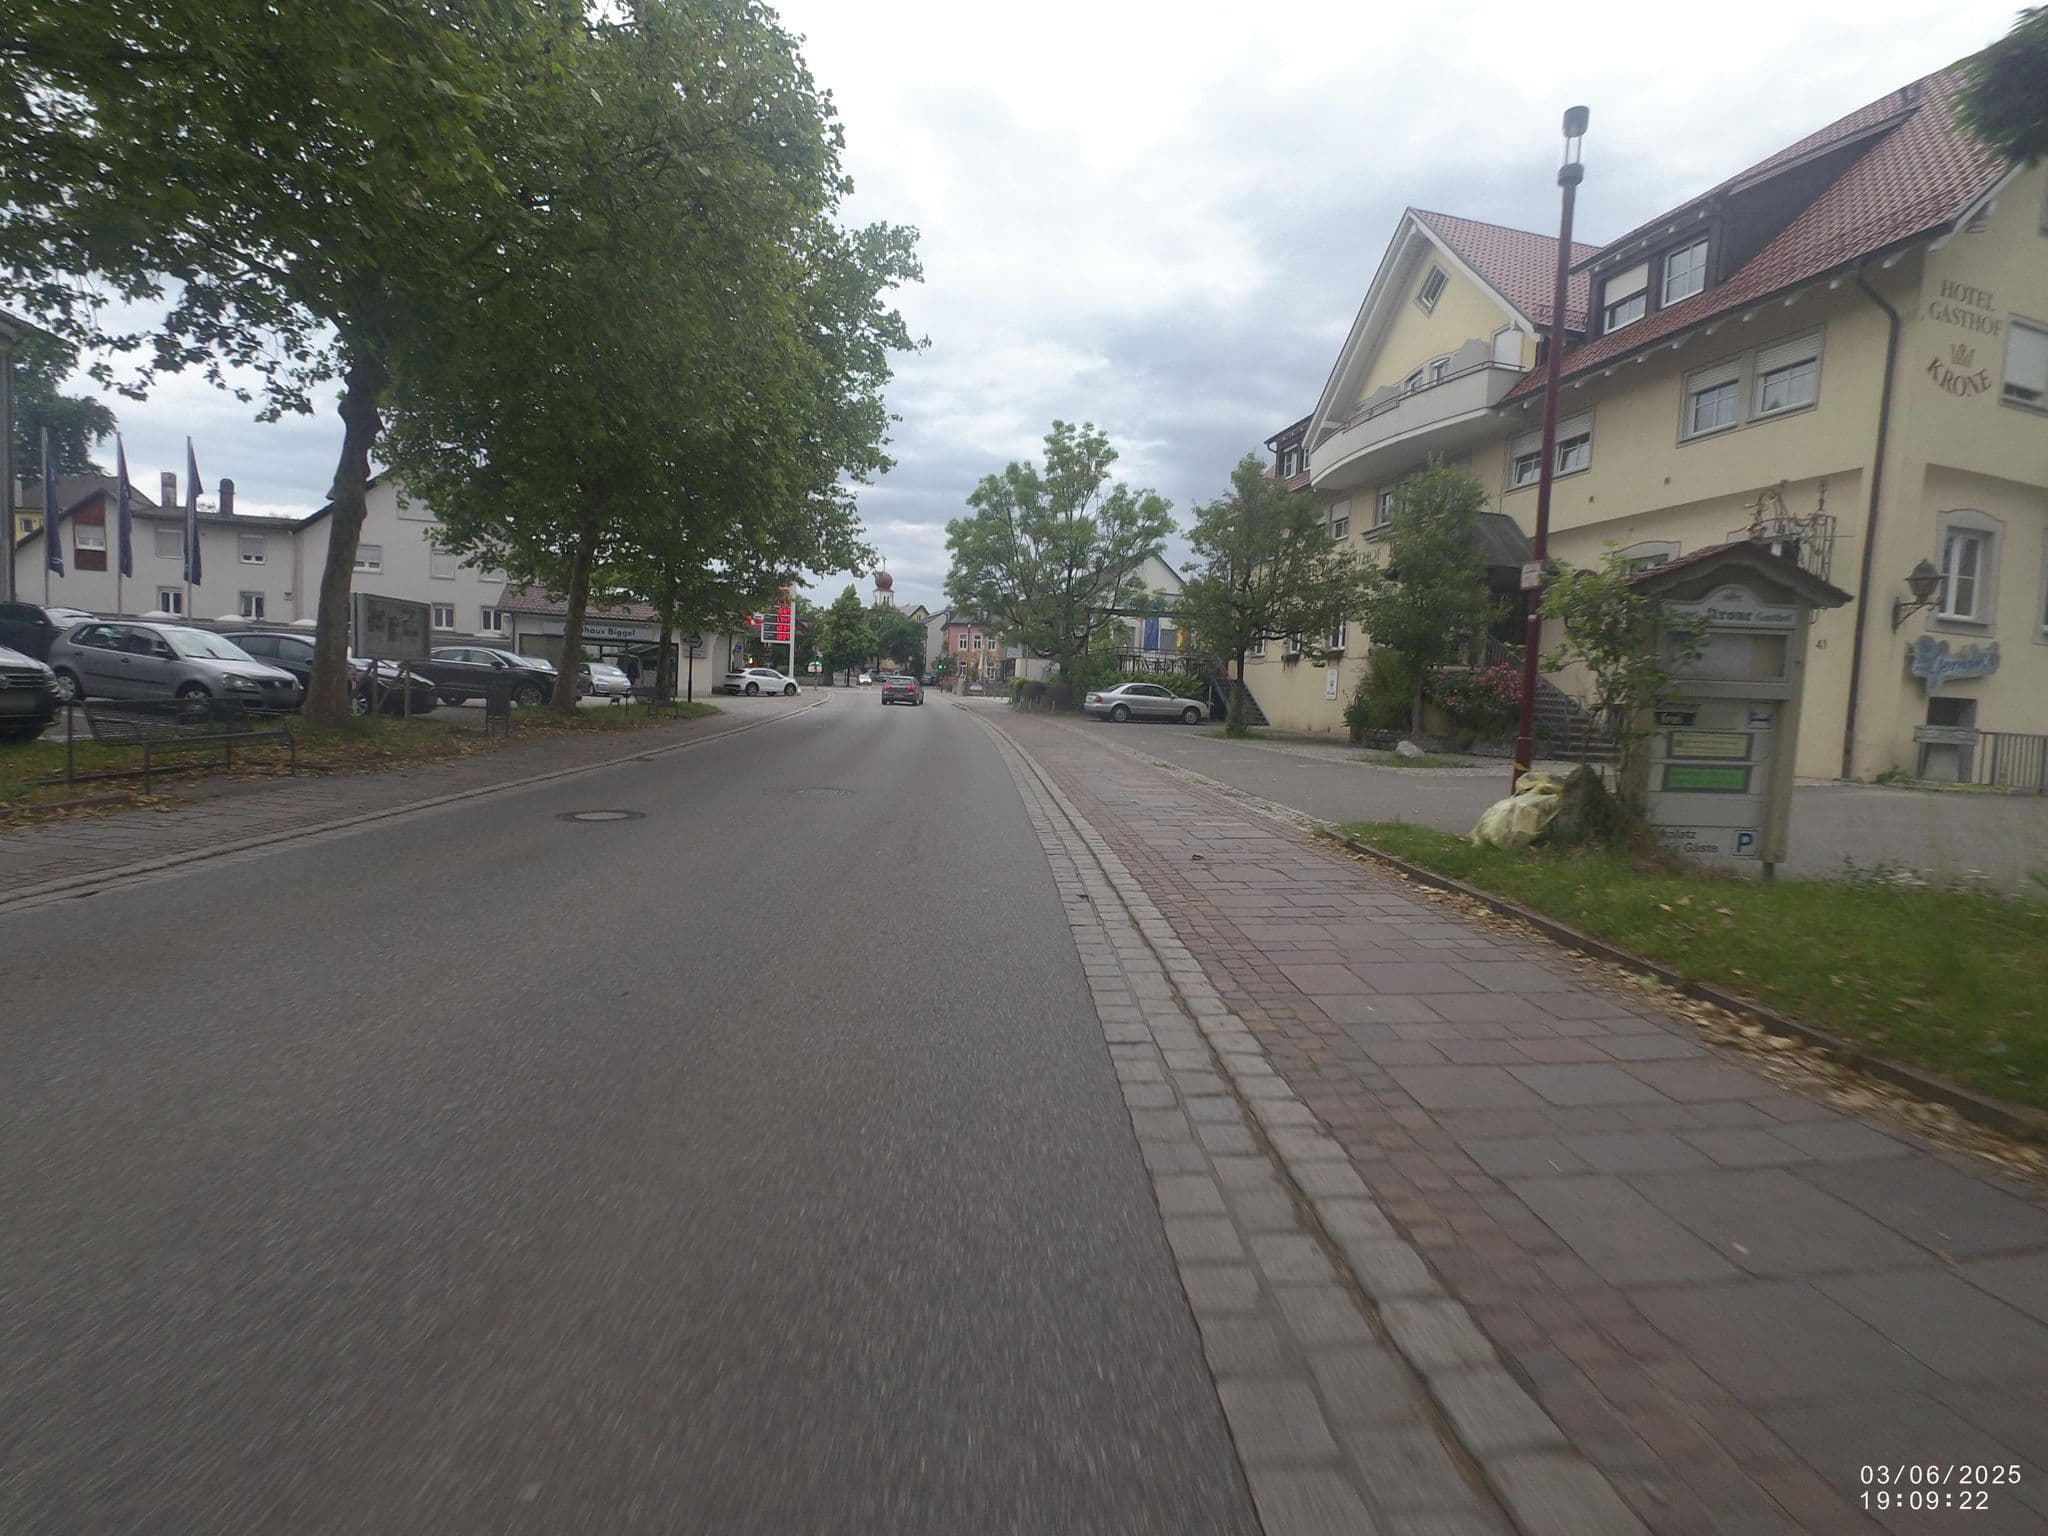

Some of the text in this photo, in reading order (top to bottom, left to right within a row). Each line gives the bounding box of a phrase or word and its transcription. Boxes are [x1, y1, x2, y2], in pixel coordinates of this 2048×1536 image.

[1941, 279, 1997, 312] HOTEL
[1928, 300, 2003, 336] GASTHOF
[1926, 356, 1993, 397] KRONE
[608, 627, 636, 638] Biggel
